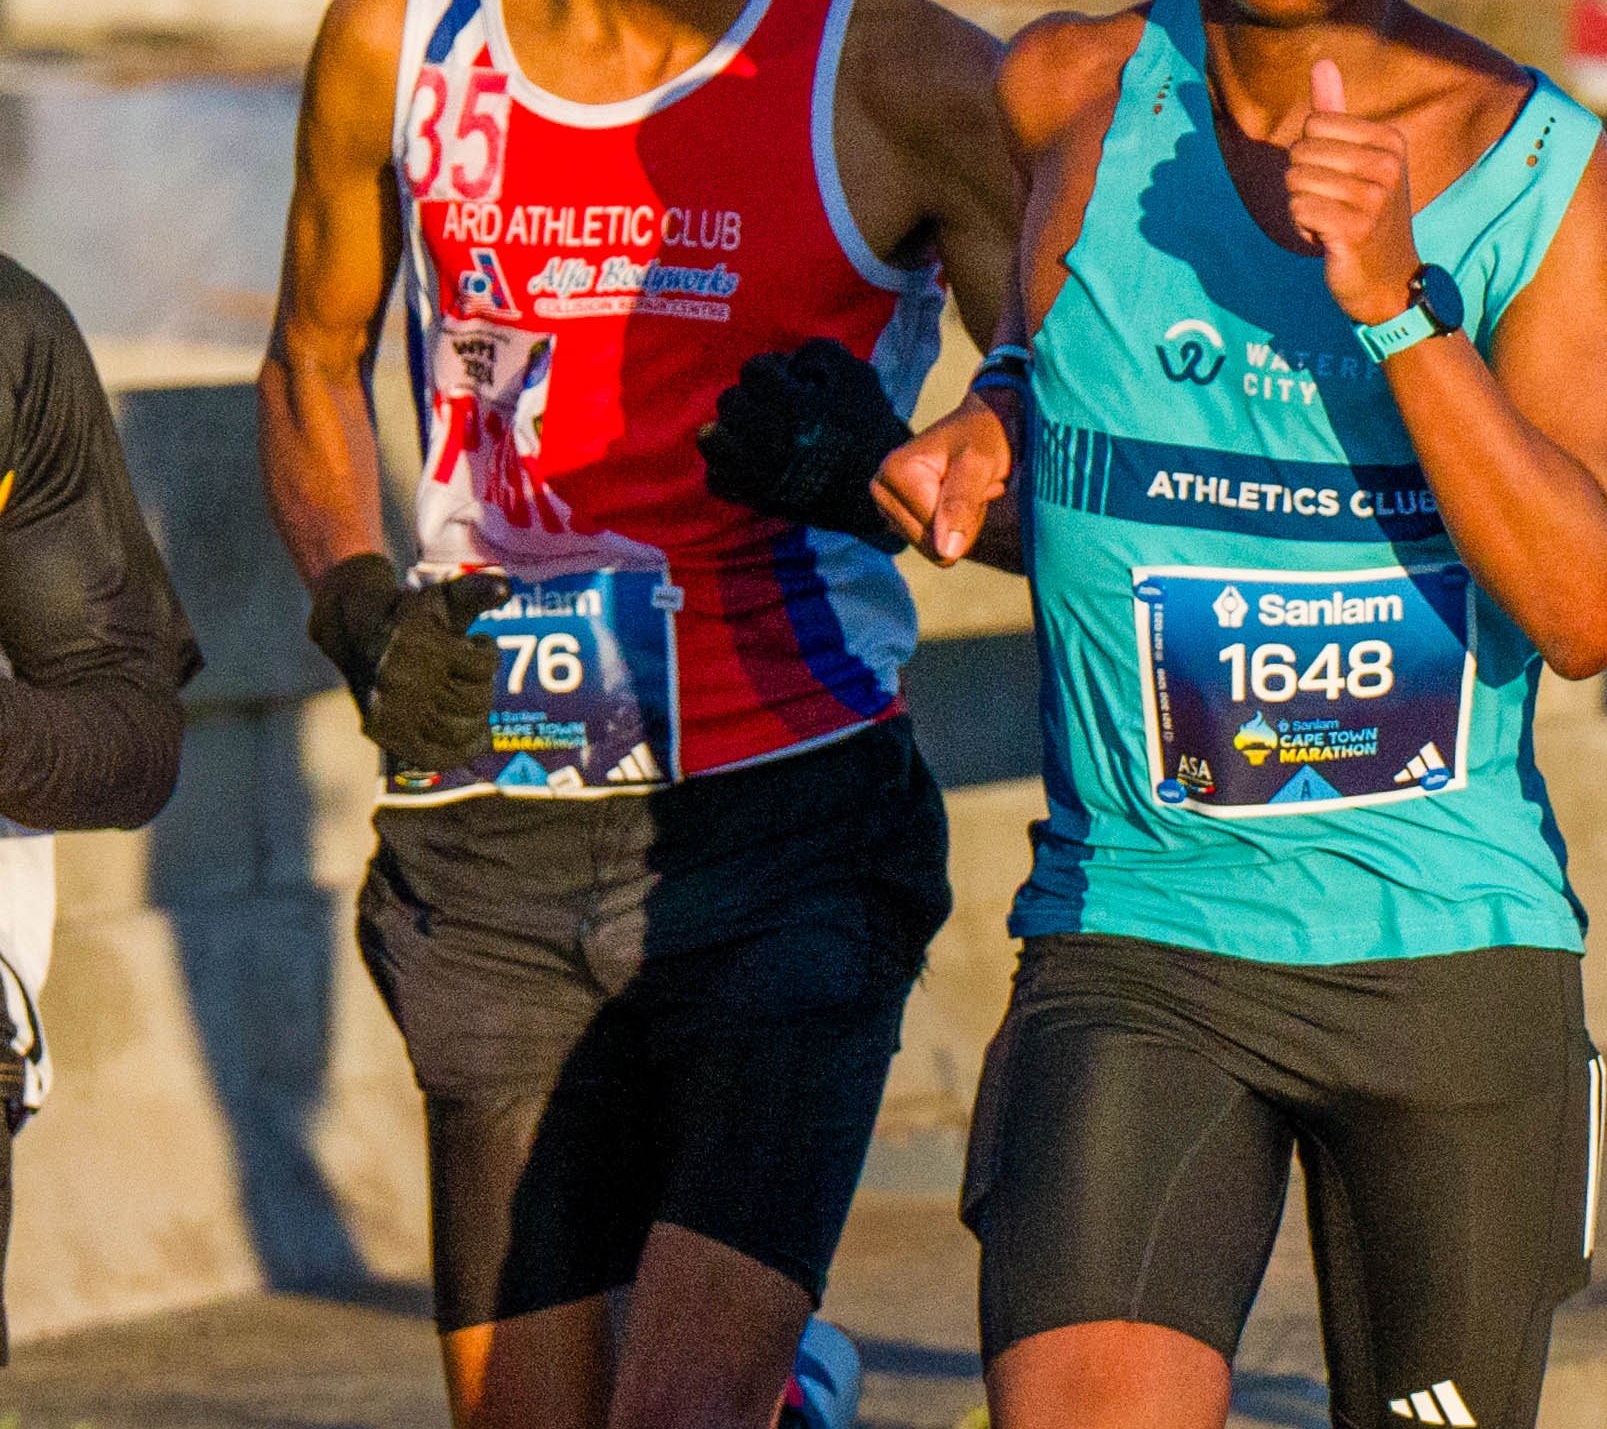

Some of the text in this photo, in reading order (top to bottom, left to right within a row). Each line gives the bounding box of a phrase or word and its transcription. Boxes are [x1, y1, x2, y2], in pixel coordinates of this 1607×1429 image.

[404, 66, 508, 199] 35
[505, 205, 655, 247] ATHLETIC
[661, 206, 742, 251] CLUB
[527, 256, 597, 297] Alfa
[1243, 372, 1317, 405] CITY
[1147, 470, 1438, 518] ATHLETICS CLUB
[1258, 591, 1403, 626] Sanlam
[1218, 639, 1394, 703] 1648
[1279, 727, 1377, 748] CAPE TOWN
[1292, 718, 1339, 731] Sanlam
[1178, 754, 1212, 780] ASA
[1279, 743, 1378, 763] MARATHON
[1301, 780, 1312, 797] A
